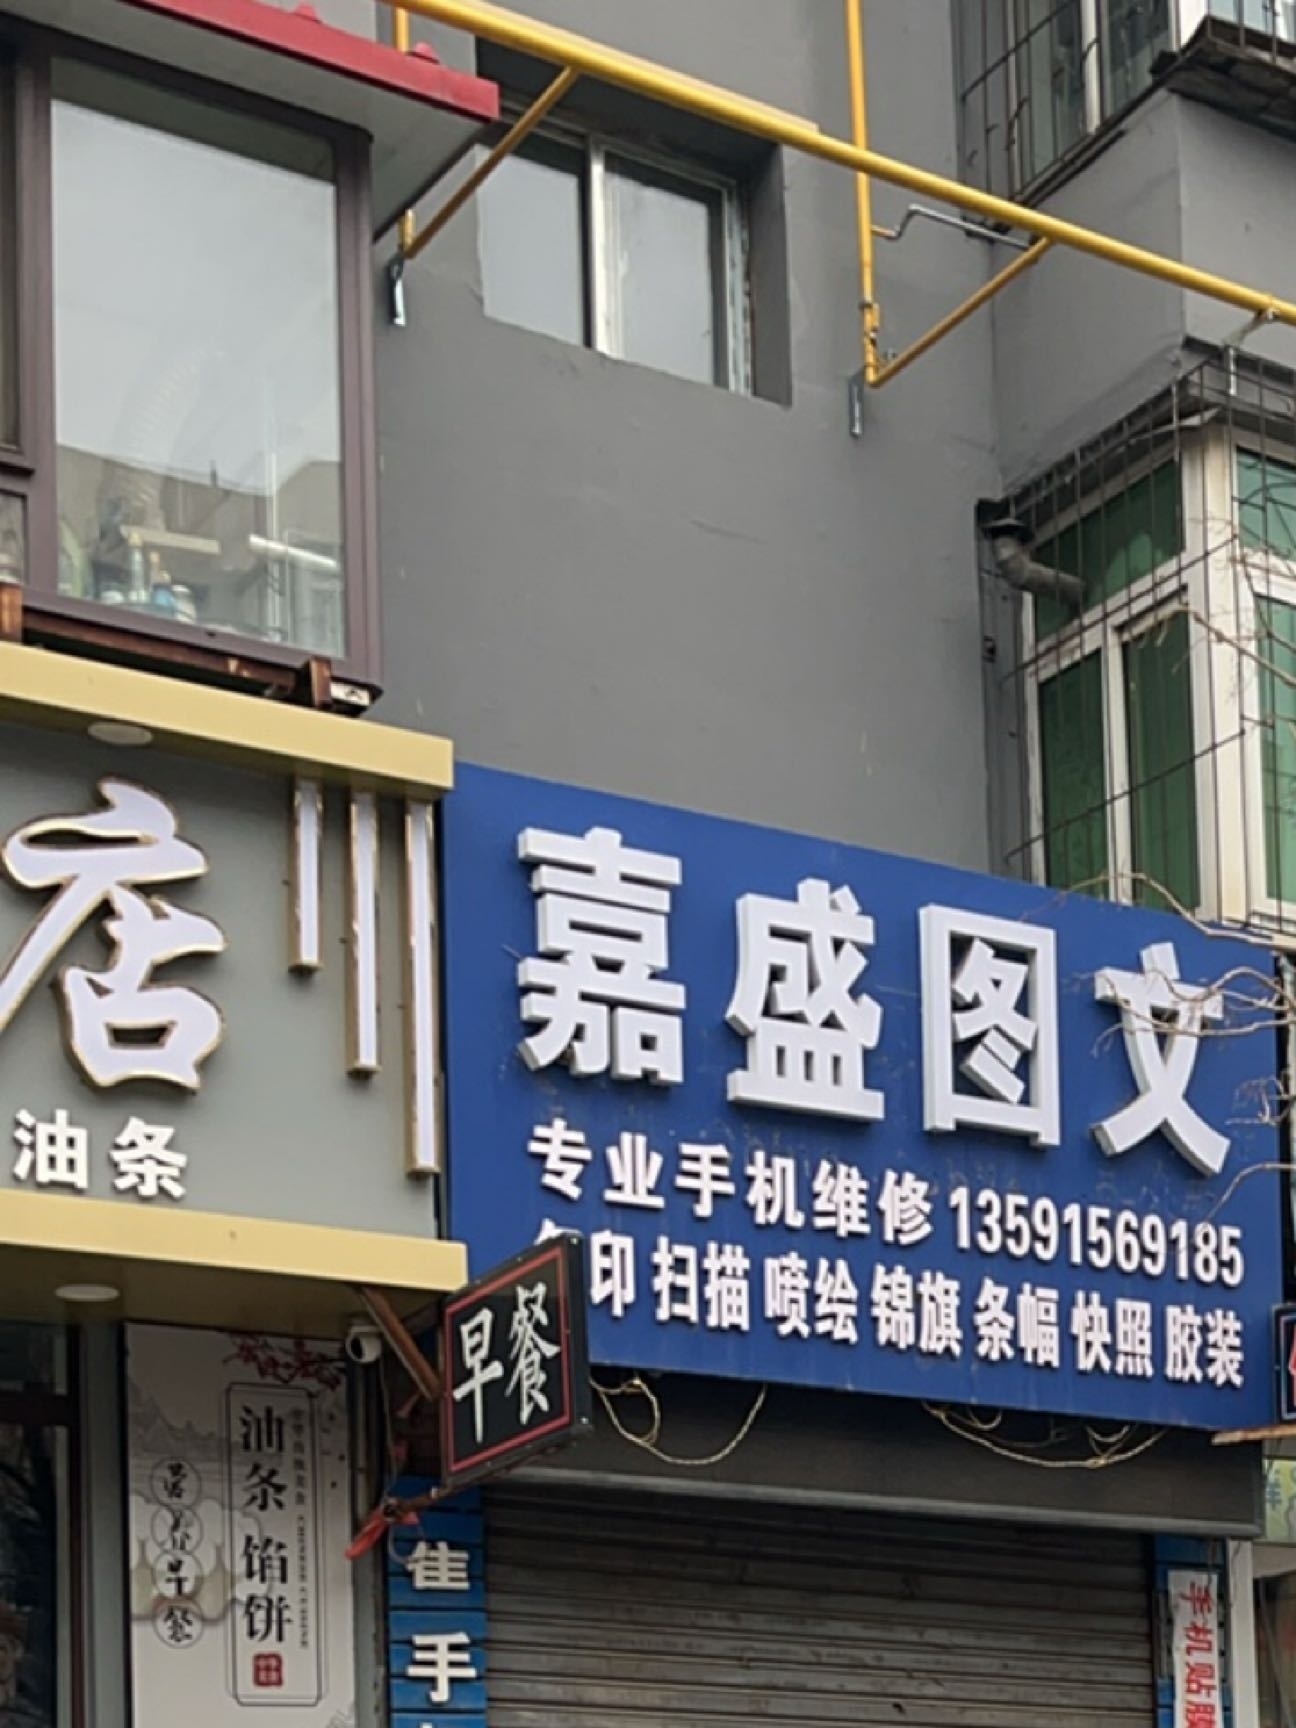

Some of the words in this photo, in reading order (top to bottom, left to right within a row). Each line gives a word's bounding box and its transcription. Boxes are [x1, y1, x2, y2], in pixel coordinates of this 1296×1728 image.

[0, 777, 228, 1090] 店
[517, 825, 1231, 1176] 嘉盛图文
[13, 1109, 187, 1199] 油条
[528, 1117, 935, 1247] 专业手机维修
[949, 1186, 1244, 1288] 13591569185
[452, 1281, 562, 1444] 早餐
[652, 1235, 751, 1333] 扫描
[764, 1251, 860, 1346] 喷绘
[870, 1263, 963, 1358] 锦旗
[973, 1283, 1061, 1371] 条幅
[1071, 1290, 1154, 1382] 快照
[1165, 1303, 1245, 1390] 胶装
[239, 1404, 288, 1513] 油条
[243, 1533, 294, 1644] 馅饼
